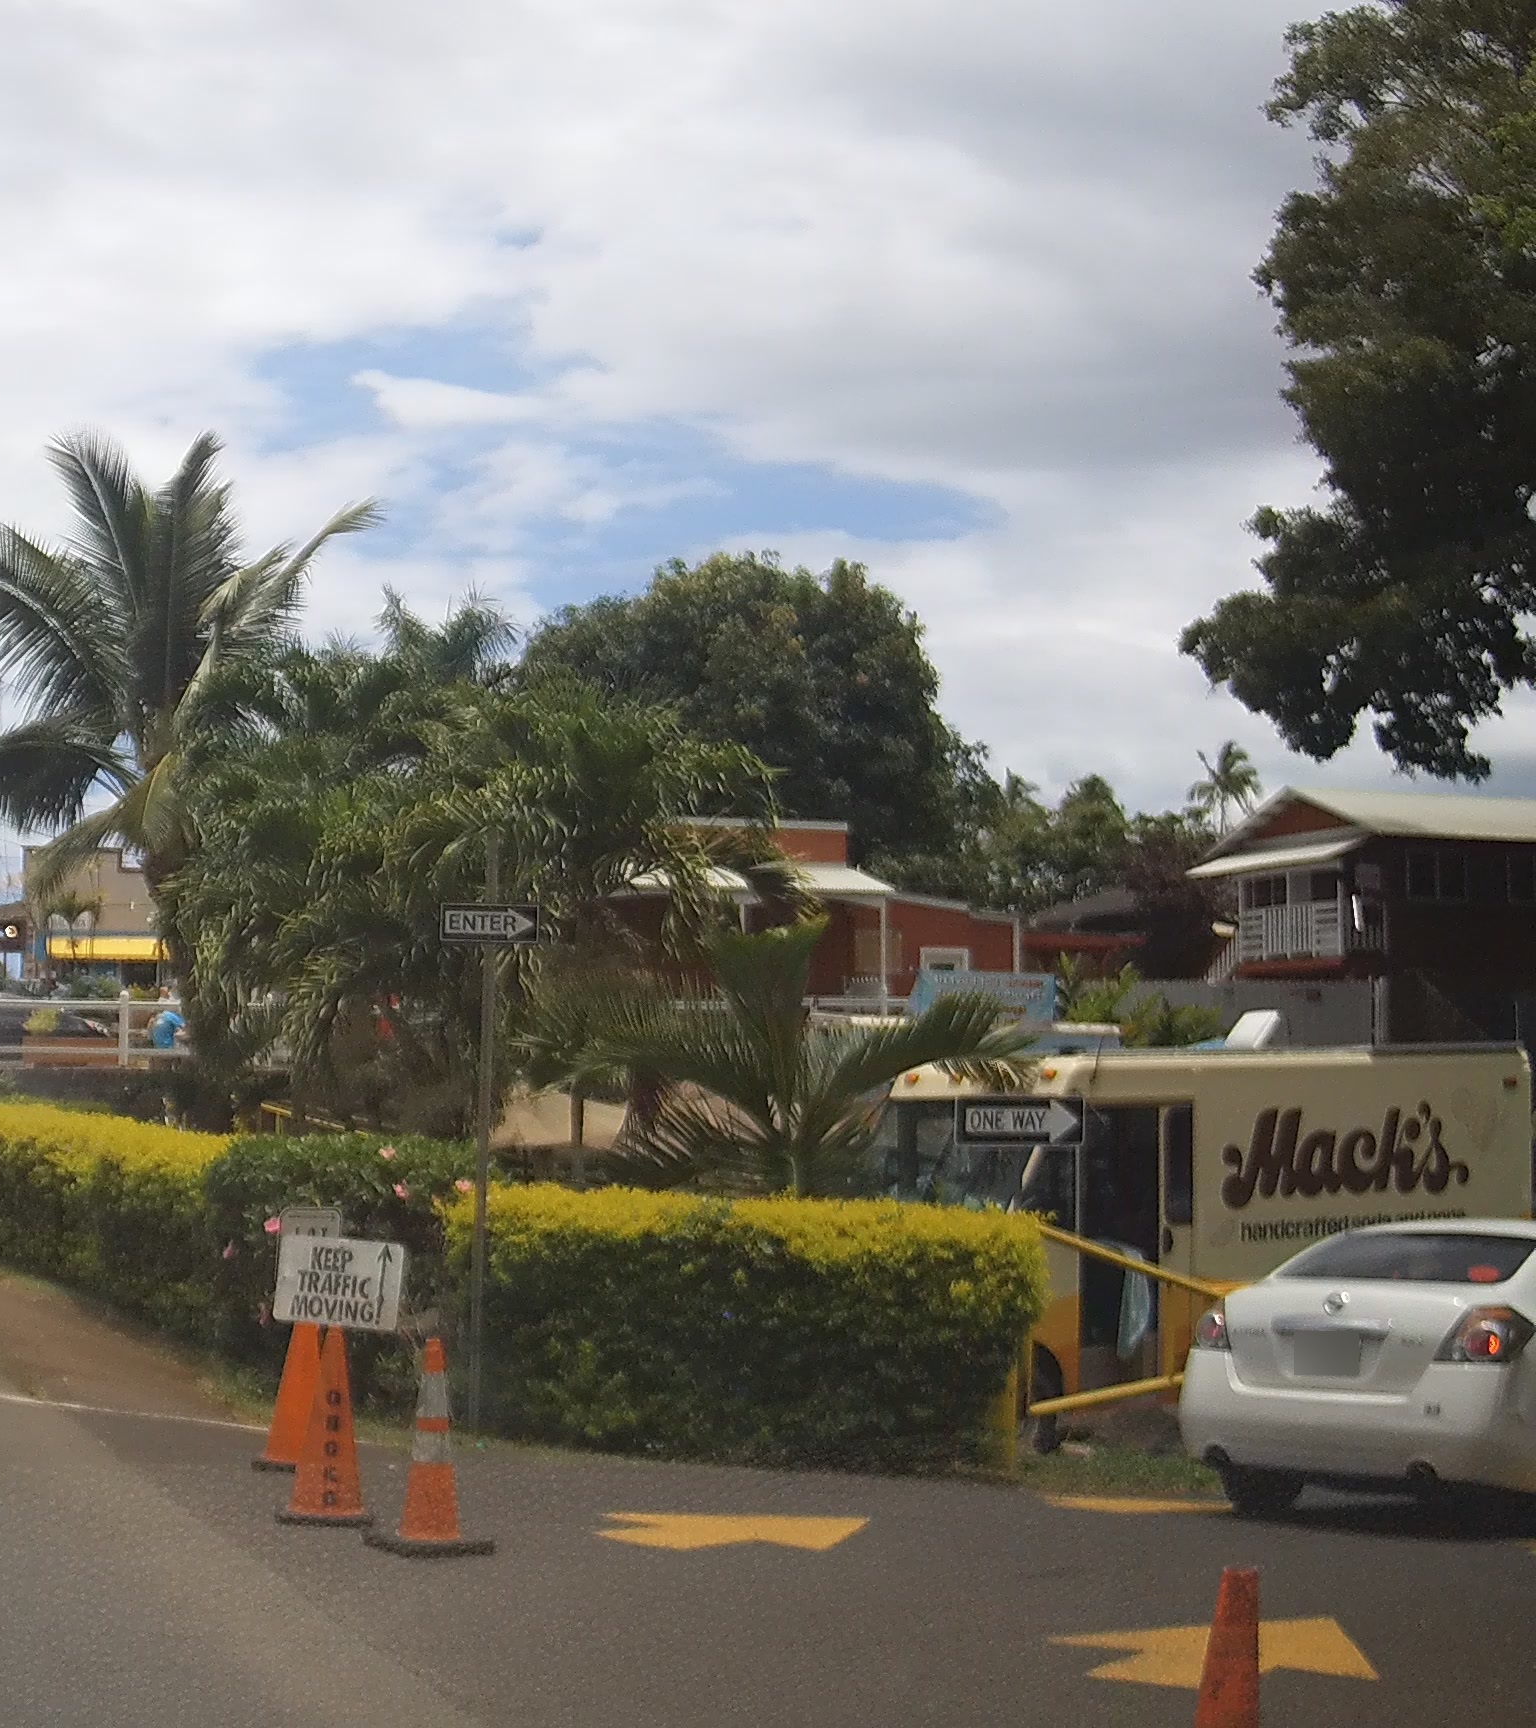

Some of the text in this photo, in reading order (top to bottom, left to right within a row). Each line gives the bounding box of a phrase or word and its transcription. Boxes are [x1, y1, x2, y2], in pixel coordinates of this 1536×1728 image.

[448, 913, 517, 932] ENTER
[970, 1109, 1046, 1130] ONE WAY
[1221, 1099, 1470, 1209] Mack's
[1239, 1214, 1349, 1242] handcrafted
[309, 1246, 353, 1272] KEEP
[297, 1268, 372, 1299] TRAFFIC
[289, 1294, 384, 1324] MOVING!
